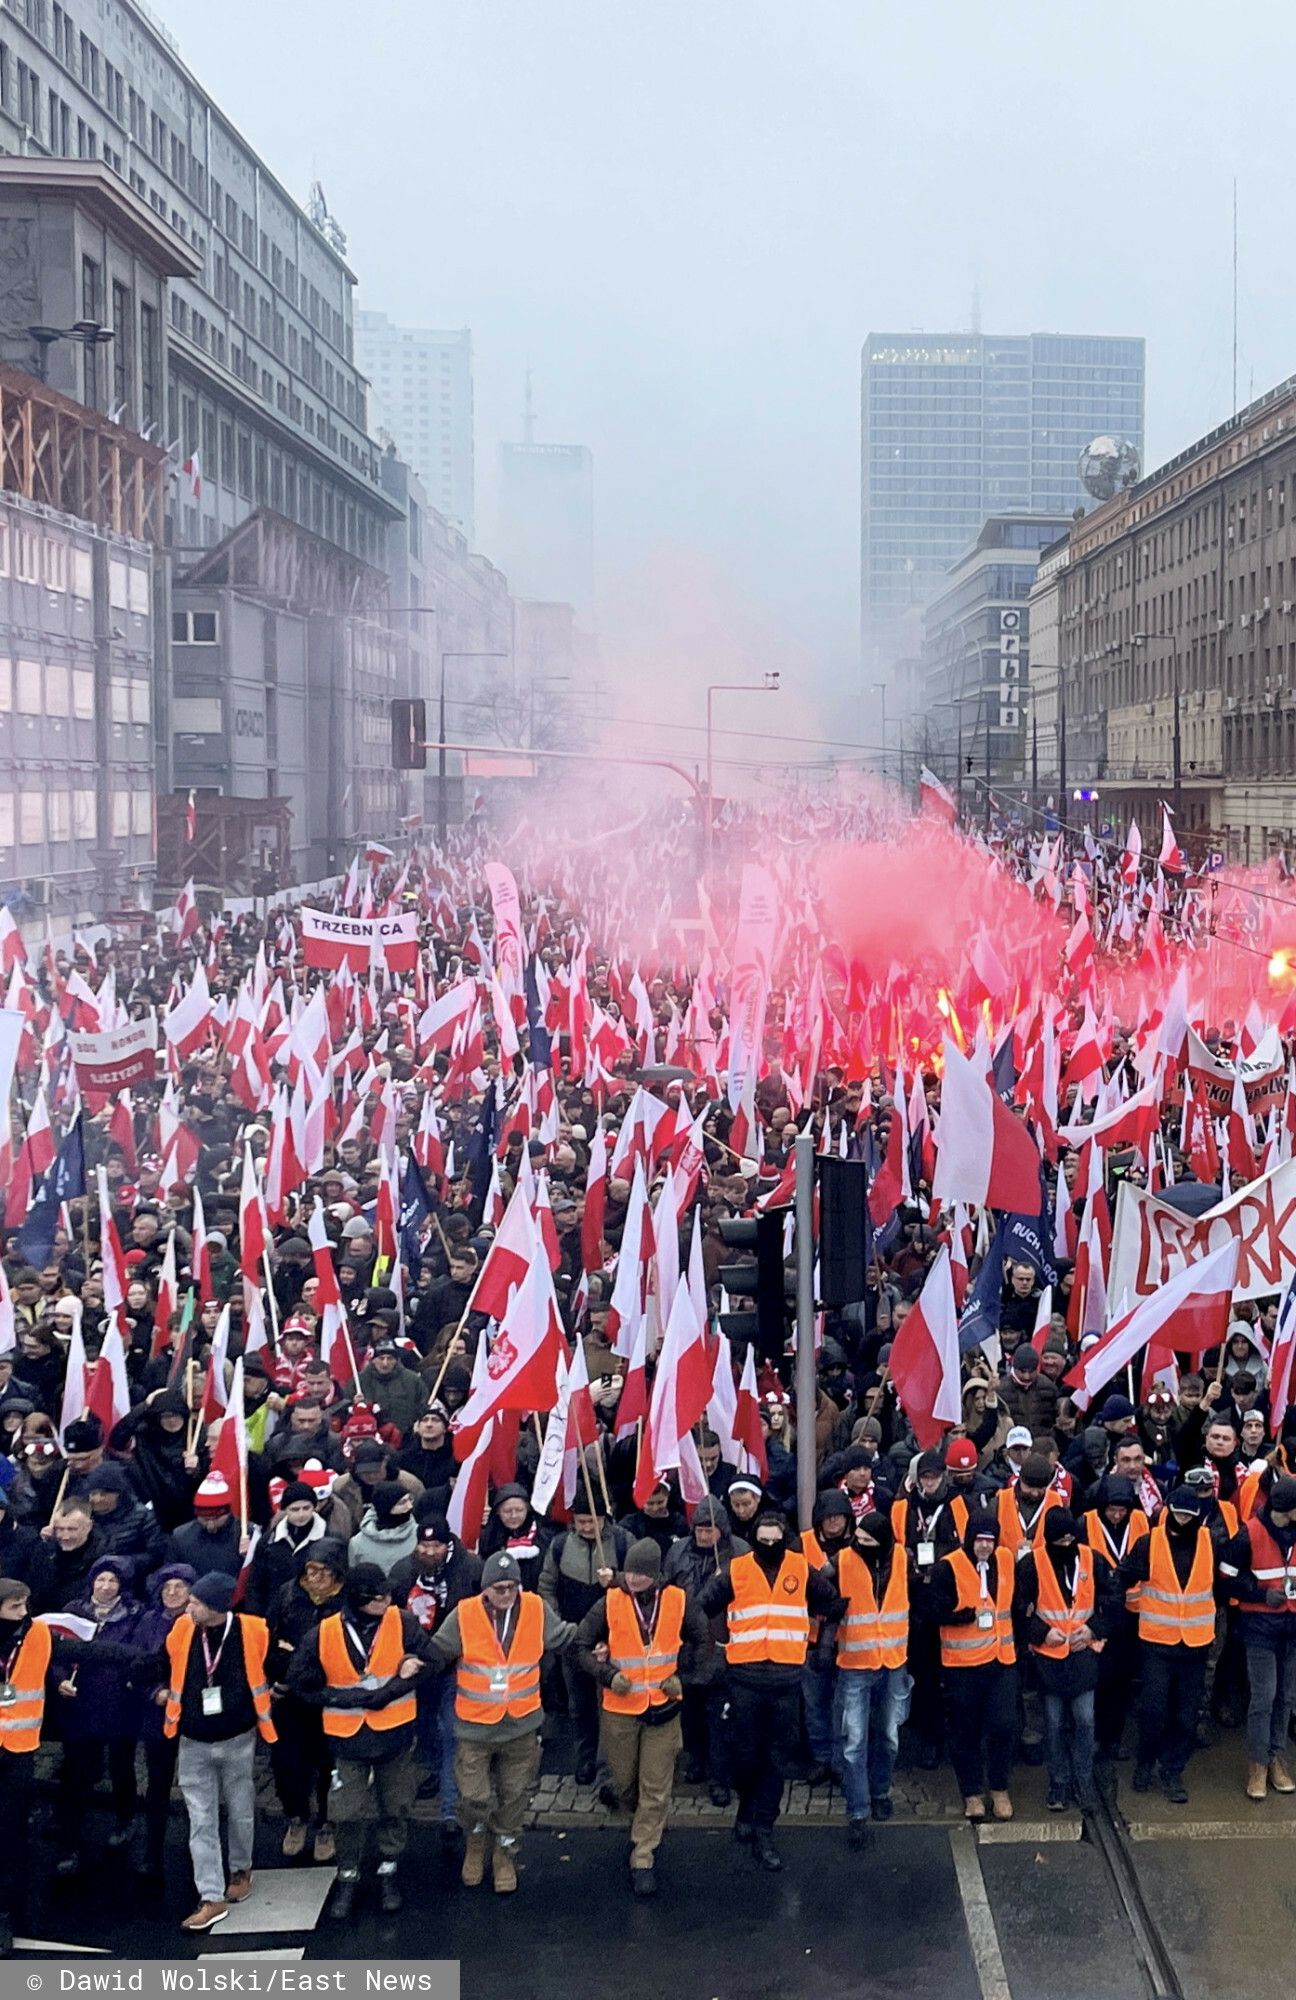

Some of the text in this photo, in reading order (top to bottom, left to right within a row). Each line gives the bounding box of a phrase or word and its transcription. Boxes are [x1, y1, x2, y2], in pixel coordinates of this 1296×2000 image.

[1003, 612, 1019, 724] Orbis
[1211, 853, 1222, 867] P
[312, 918, 403, 936] TRZEBNCA
[1011, 1221, 1041, 1251] RUCH
